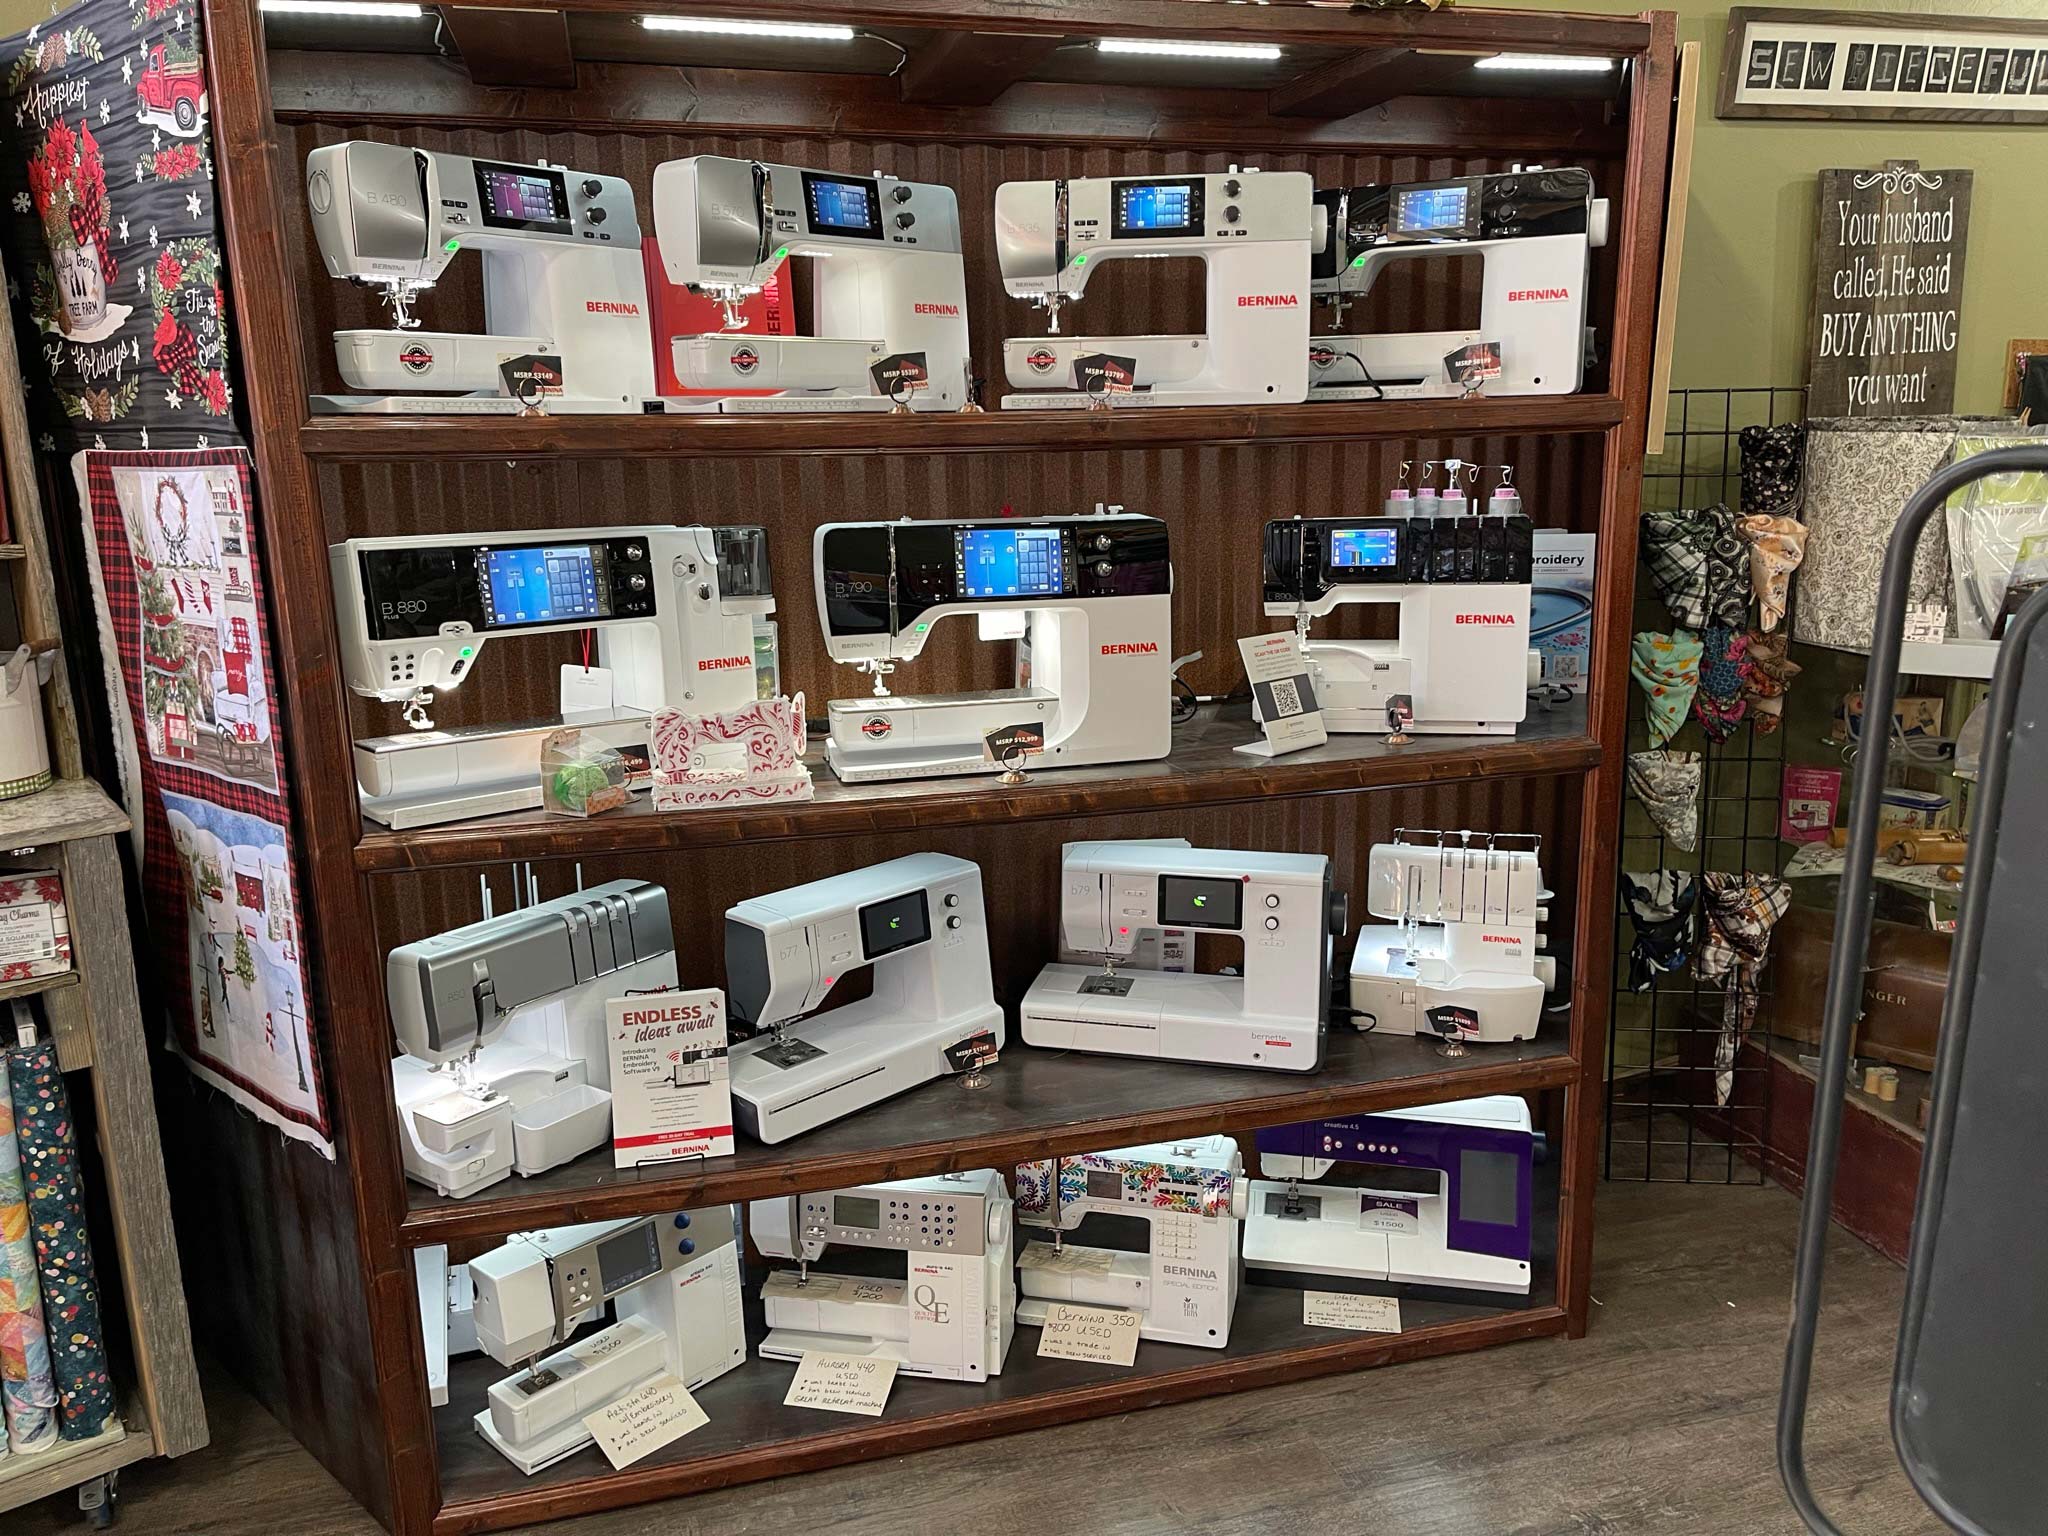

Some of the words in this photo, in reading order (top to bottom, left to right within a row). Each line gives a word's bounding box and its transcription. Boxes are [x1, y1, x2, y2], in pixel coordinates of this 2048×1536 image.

[1749, 48, 1834, 82] SEW
[22, 74, 90, 129] Happiest
[367, 191, 378, 204] B
[382, 193, 407, 207] 480
[1838, 200, 1880, 246] Your
[1882, 196, 1954, 244] husband
[372, 263, 406, 271] BERNINA
[1834, 255, 1888, 302] called,
[1890, 255, 1915, 296] He
[1918, 253, 1952, 295] said
[1237, 294, 1298, 307] BERNINA
[1508, 288, 1569, 302] BERNINA
[69, 302, 81, 317] TREE
[82, 300, 99, 316] FARM
[586, 301, 640, 315] BERNINA
[914, 303, 959, 315] BERNINA
[199, 315, 216, 337] the
[1820, 312, 1861, 357] BUY
[1860, 310, 1957, 357] ANYTHING
[71, 340, 129, 384] Holidays
[513, 371, 532, 379] MSRP
[882, 370, 901, 378] MSRP
[1084, 367, 1104, 376] MSRP
[1848, 374, 1881, 416] you
[1885, 366, 1928, 404] want
[1532, 554, 1585, 567] roidery
[835, 582, 845, 593] B
[848, 581, 873, 593] 790
[381, 602, 394, 615] B
[397, 599, 428, 614] 880
[1456, 614, 1515, 625] BERNINA
[1101, 642, 1158, 655] BERNINA
[698, 655, 751, 671] BERNINA
[995, 737, 1013, 746] MSRP
[1072, 884, 1090, 896] b79
[1482, 935, 1522, 945] BERNINA
[781, 945, 798, 960] b77
[1866, 989, 1907, 1006] NGER
[623, 1005, 702, 1026] ENDLESS
[635, 1025, 671, 1043] Ideas
[677, 1014, 715, 1034] await
[1251, 1032, 1287, 1041] bernette
[622, 1047, 656, 1056] Introducing
[622, 1054, 649, 1062] BERNINA
[623, 1061, 657, 1070] Embroidery
[671, 1144, 710, 1155] BERNINA
[1376, 1201, 1403, 1209] SALE
[1373, 1220, 1404, 1228] $1500
[1163, 1265, 1217, 1279] BERNINA
[680, 1274, 701, 1288] BERNINA
[1163, 1280, 1190, 1289] SPECIAL
[1192, 1282, 1219, 1292] EDITION
[856, 1284, 883, 1292] USED
[1058, 1306, 1105, 1323] Bernina
[1110, 1314, 1135, 1327] 350
[1048, 1322, 1071, 1333] $800
[1076, 1326, 1112, 1338] USED
[857, 1362, 876, 1373] 440
[836, 1372, 858, 1380] USED
[640, 1386, 658, 1399] 640
